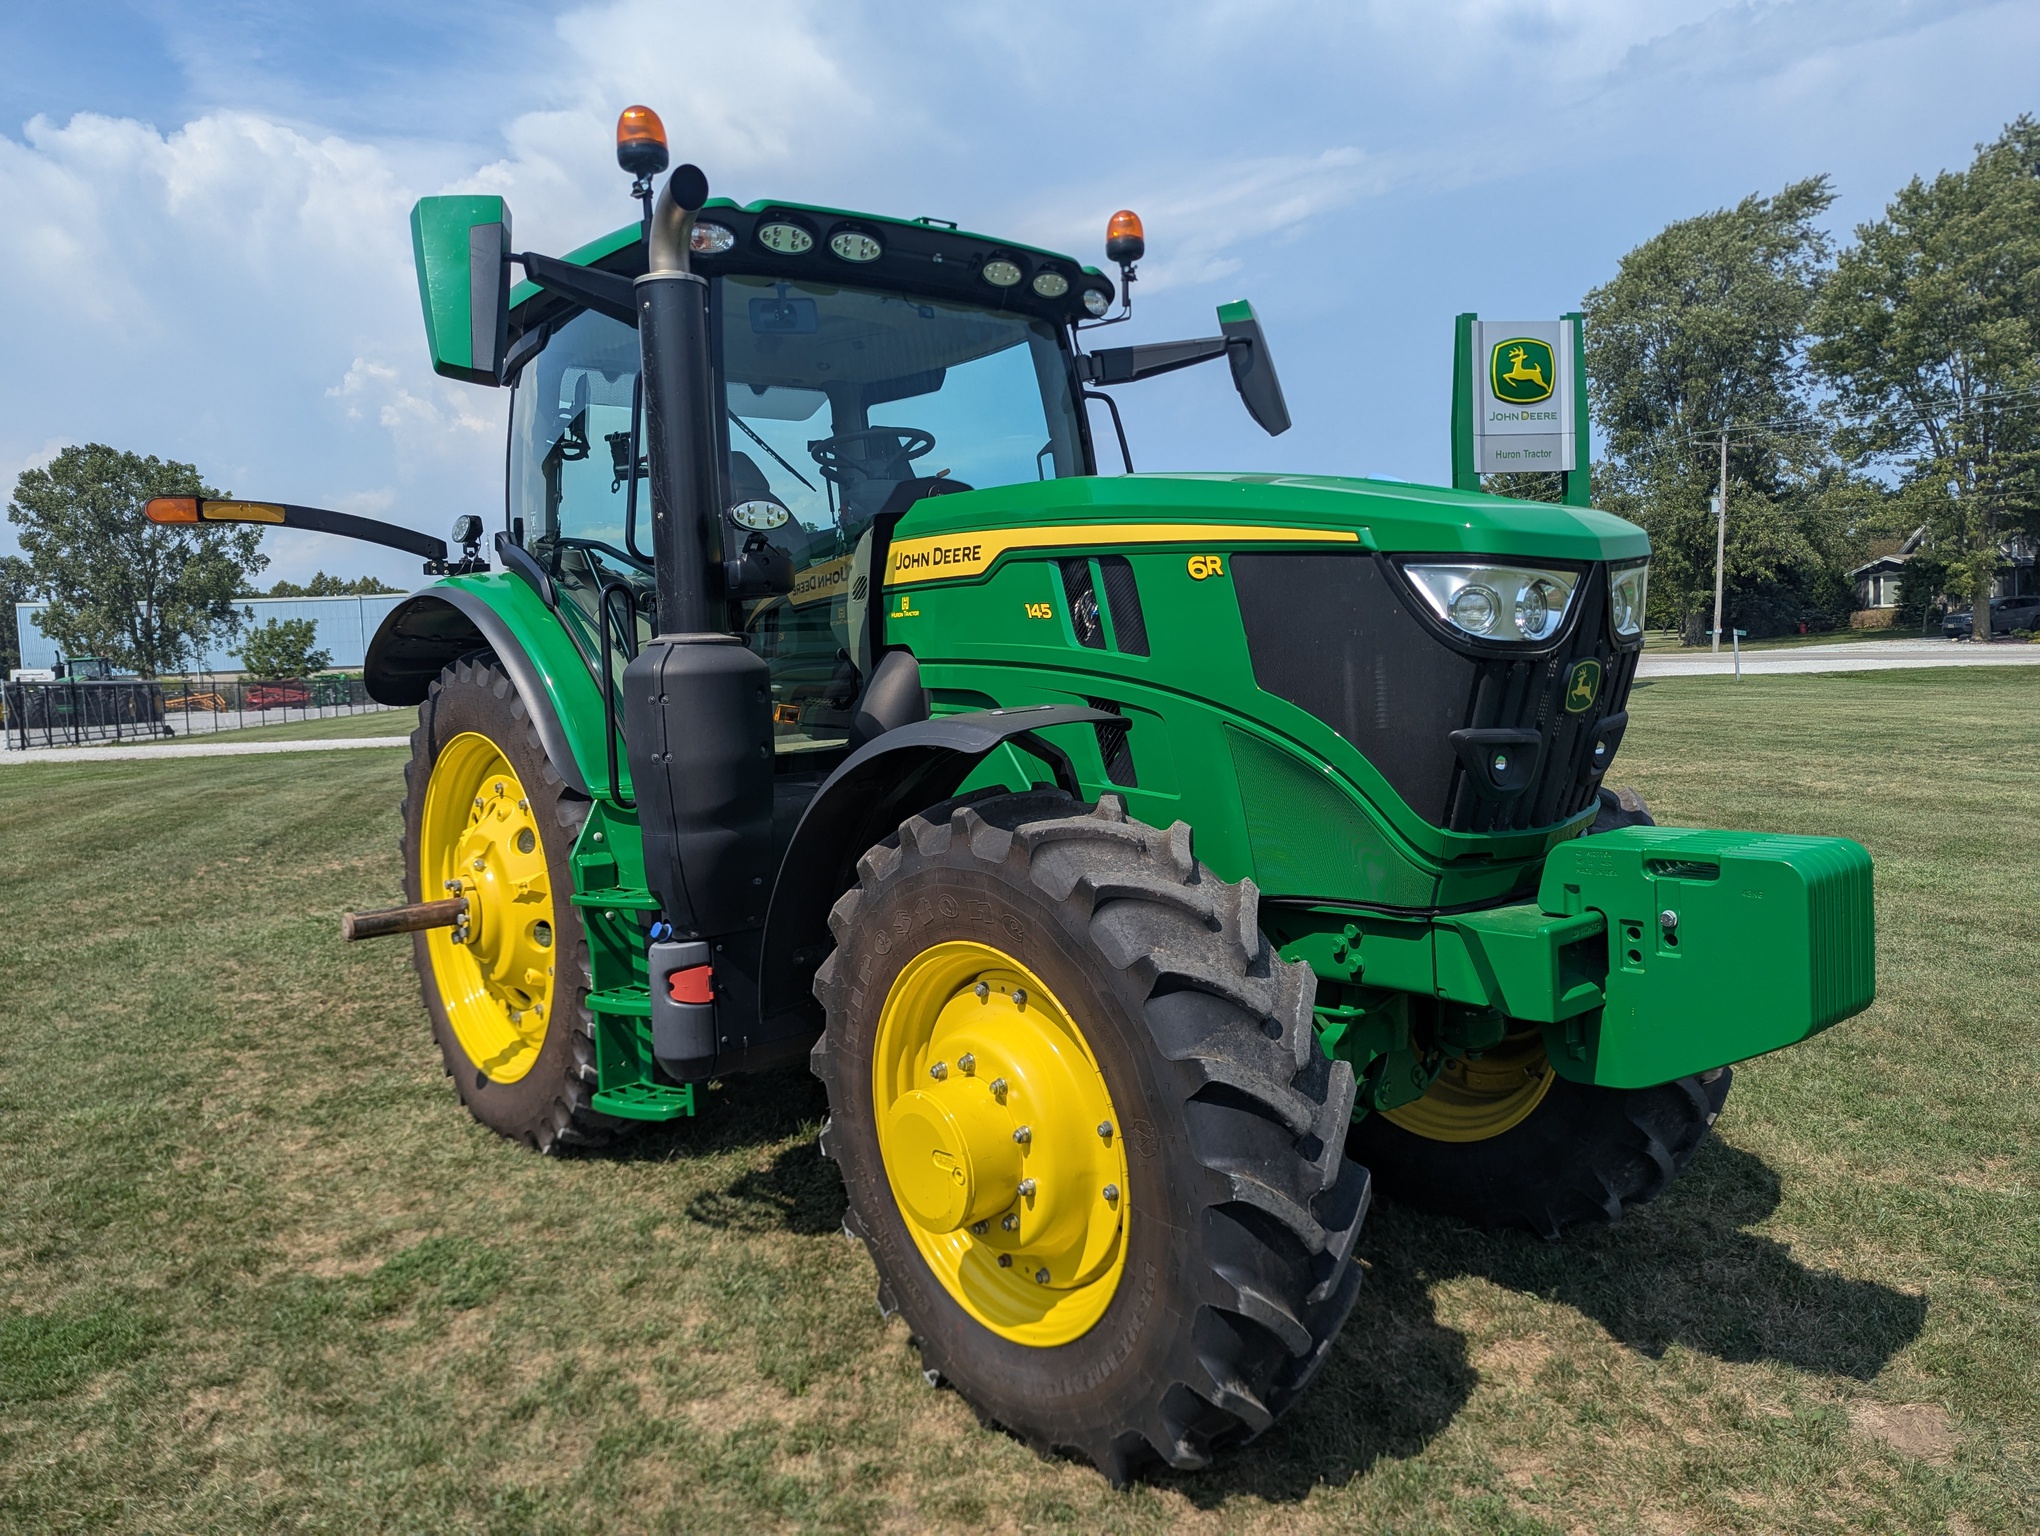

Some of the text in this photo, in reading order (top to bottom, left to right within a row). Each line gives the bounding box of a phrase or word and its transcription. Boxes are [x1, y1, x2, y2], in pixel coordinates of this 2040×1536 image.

[1489, 410, 1558, 422] JOHN DEERE
[1495, 449, 1552, 459] Huron Tractor
[895, 544, 982, 571] JOHN DEERE
[1186, 554, 1225, 581] 6R
[1024, 602, 1053, 620] 145
